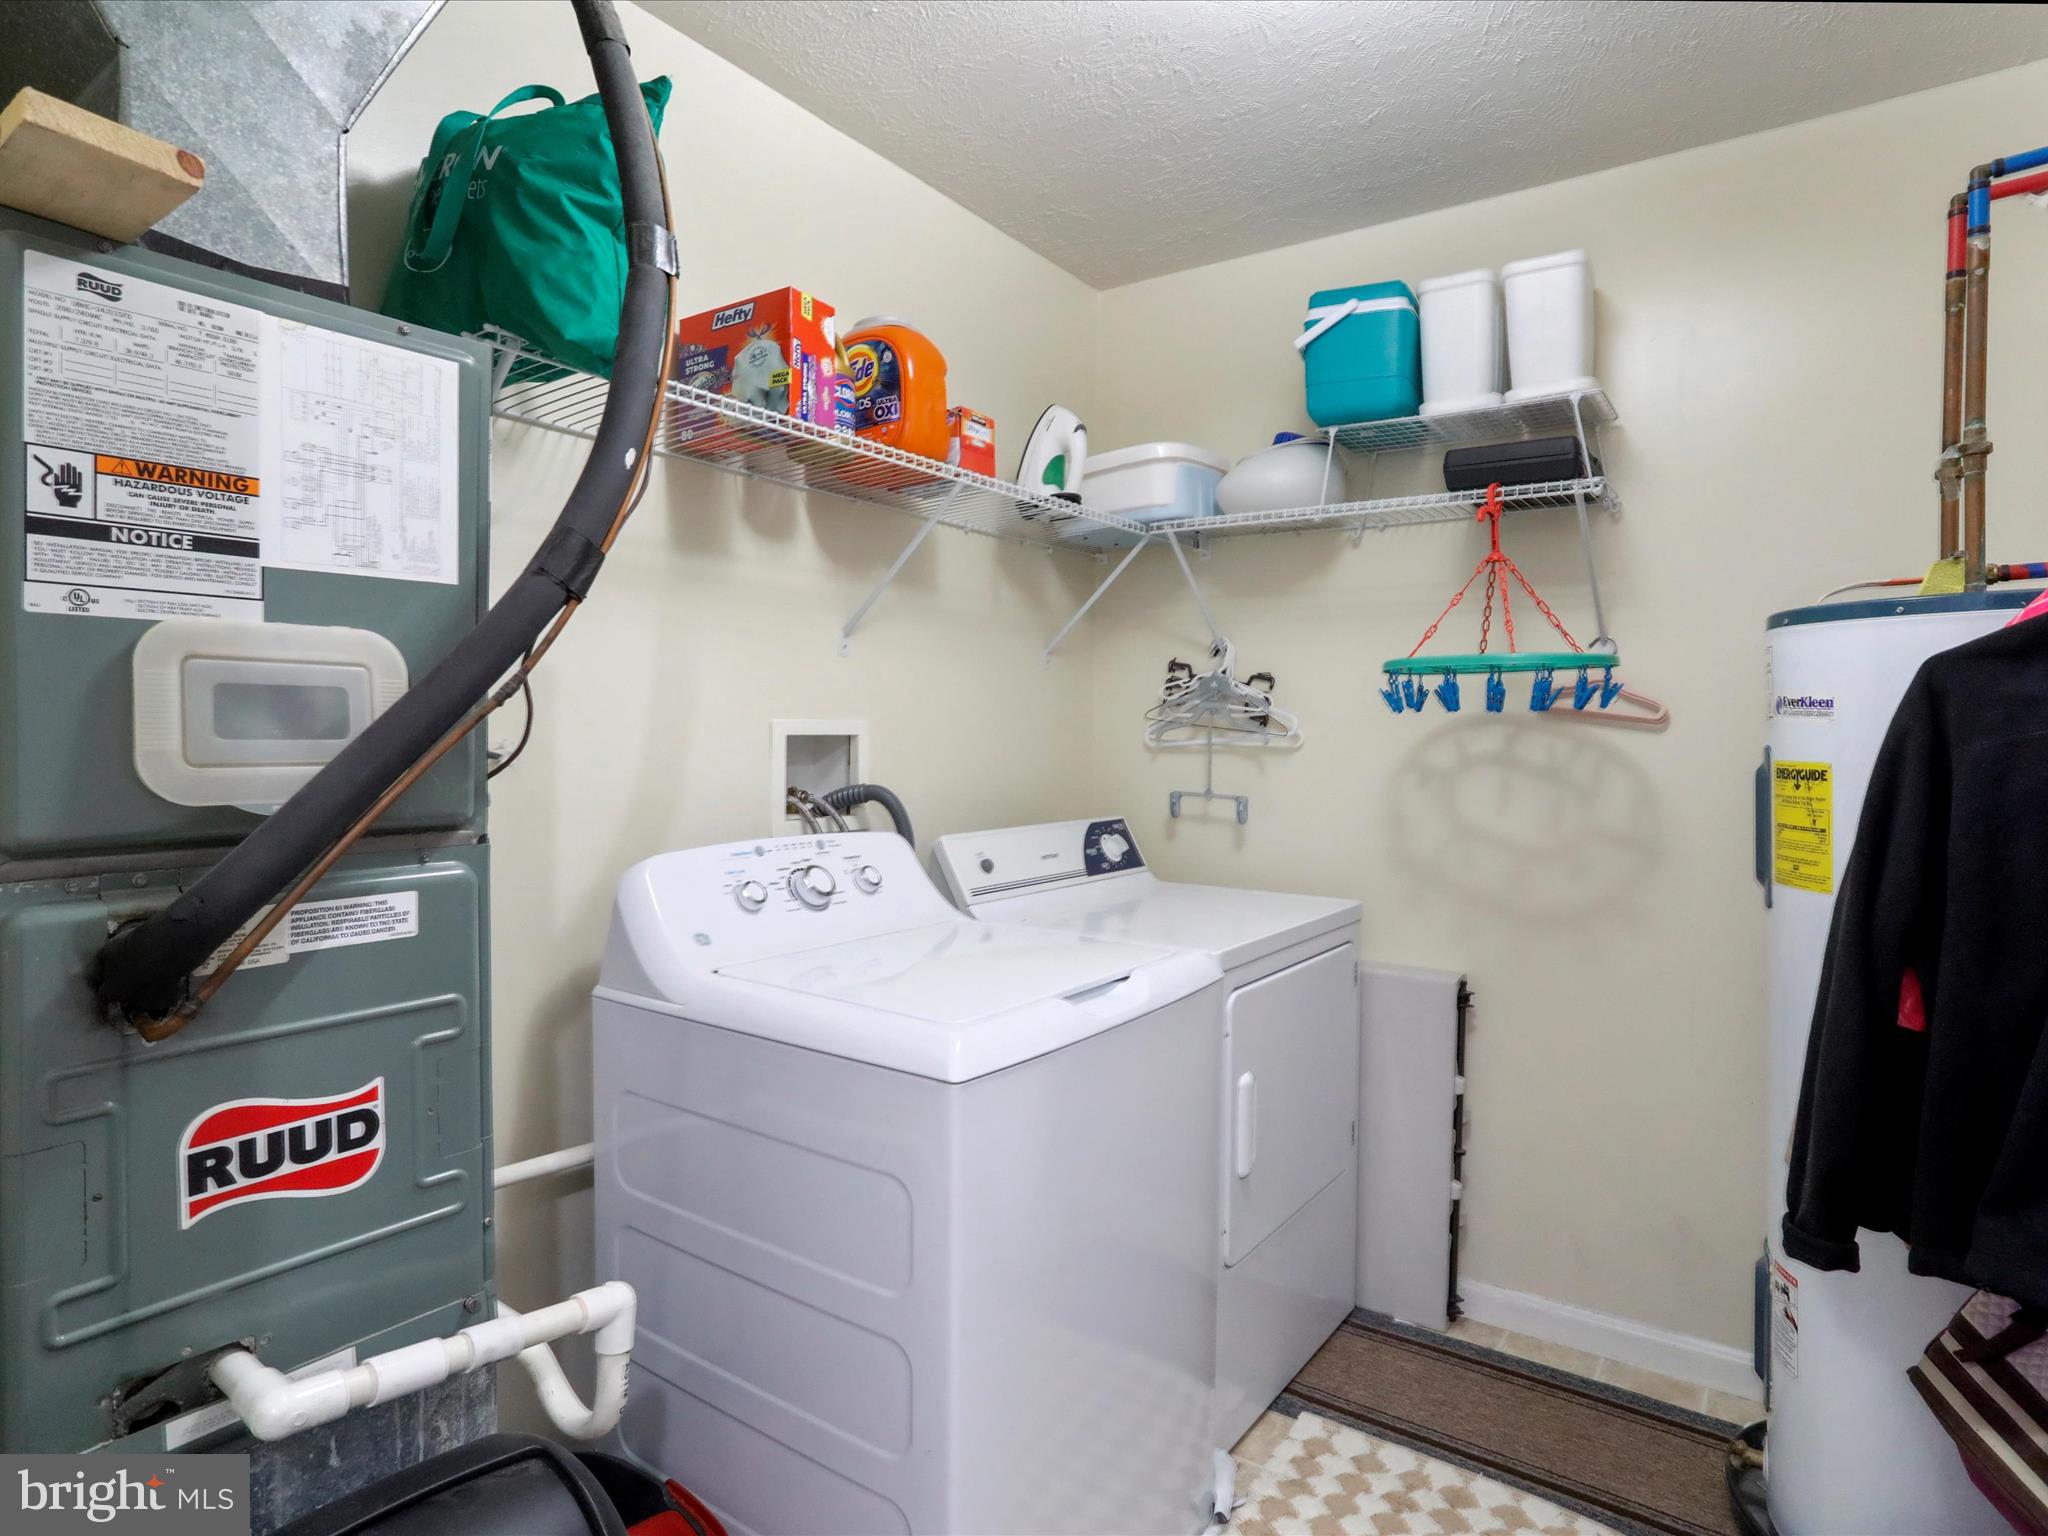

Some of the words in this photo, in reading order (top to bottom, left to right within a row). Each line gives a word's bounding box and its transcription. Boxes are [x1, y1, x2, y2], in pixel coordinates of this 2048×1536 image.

[77, 278, 122, 296] RUUD
[713, 307, 752, 328] Hefty
[684, 360, 715, 375] STRONG
[685, 354, 709, 367] ULTRA
[772, 371, 790, 379] MEGA
[876, 395, 898, 406] ULTRA
[874, 403, 899, 419] OXI
[134, 461, 249, 493] WARNING
[114, 478, 193, 497] HAZARDOUS
[196, 490, 250, 505] VOLTAGE
[128, 492, 145, 500] CAN
[147, 494, 171, 503] CAUSE
[173, 497, 198, 506] SEVERE
[200, 501, 237, 512] PERSONAL
[150, 501, 176, 510] INJURY
[110, 527, 194, 550] NOTICE
[73, 592, 86, 604] UL
[1783, 696, 1834, 708] EverKleen
[290, 906, 334, 917] PROPOSITION
[290, 914, 327, 924] APPLIANCE
[328, 910, 359, 919] CONTAINS
[360, 906, 395, 914] FIBERGLASS
[331, 915, 369, 926] RESPIRABLE
[370, 912, 401, 921] PARTICLES
[290, 928, 330, 938] FIBERGLASS
[345, 922, 369, 931] KNOWN
[391, 917, 409, 925] STATE
[301, 935, 340, 944] CALIFORNIA
[350, 929, 371, 938] CAUSE
[187, 1108, 380, 1197] RUUD
